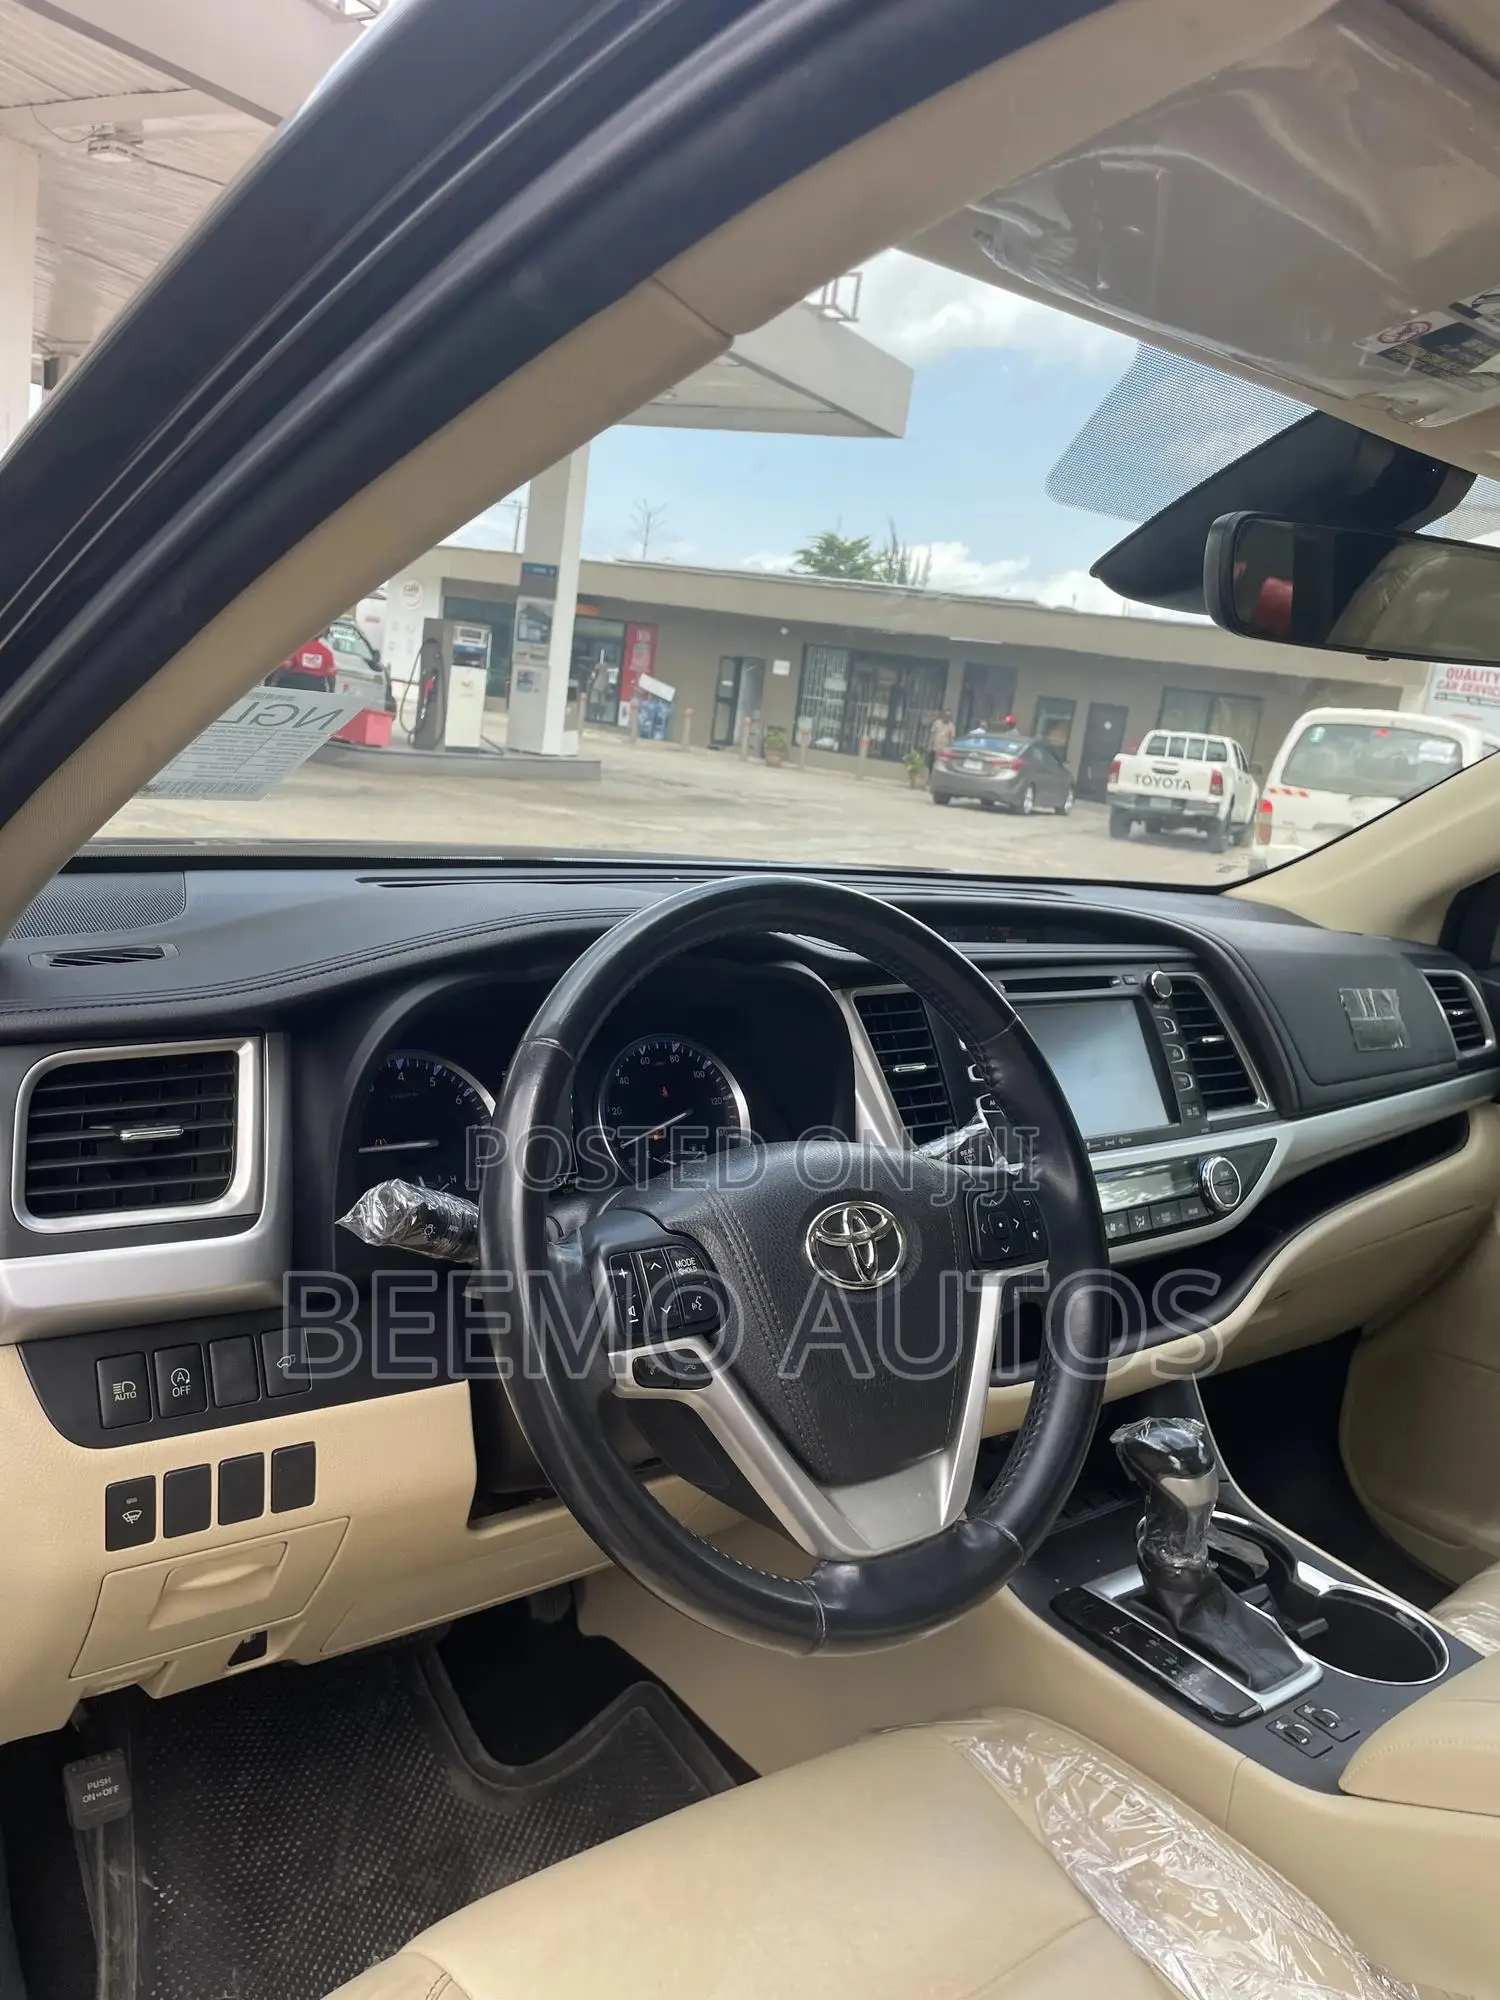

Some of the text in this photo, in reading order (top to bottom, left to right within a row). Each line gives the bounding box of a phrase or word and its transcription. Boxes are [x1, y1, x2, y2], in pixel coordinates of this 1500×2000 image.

[1134, 774, 1191, 791] TOYOTA
[675, 1256, 696, 1268] MODE
[114, 1390, 137, 1402] AUTO
[172, 1385, 192, 1398] OFF
[87, 1776, 112, 1790] PUSH
